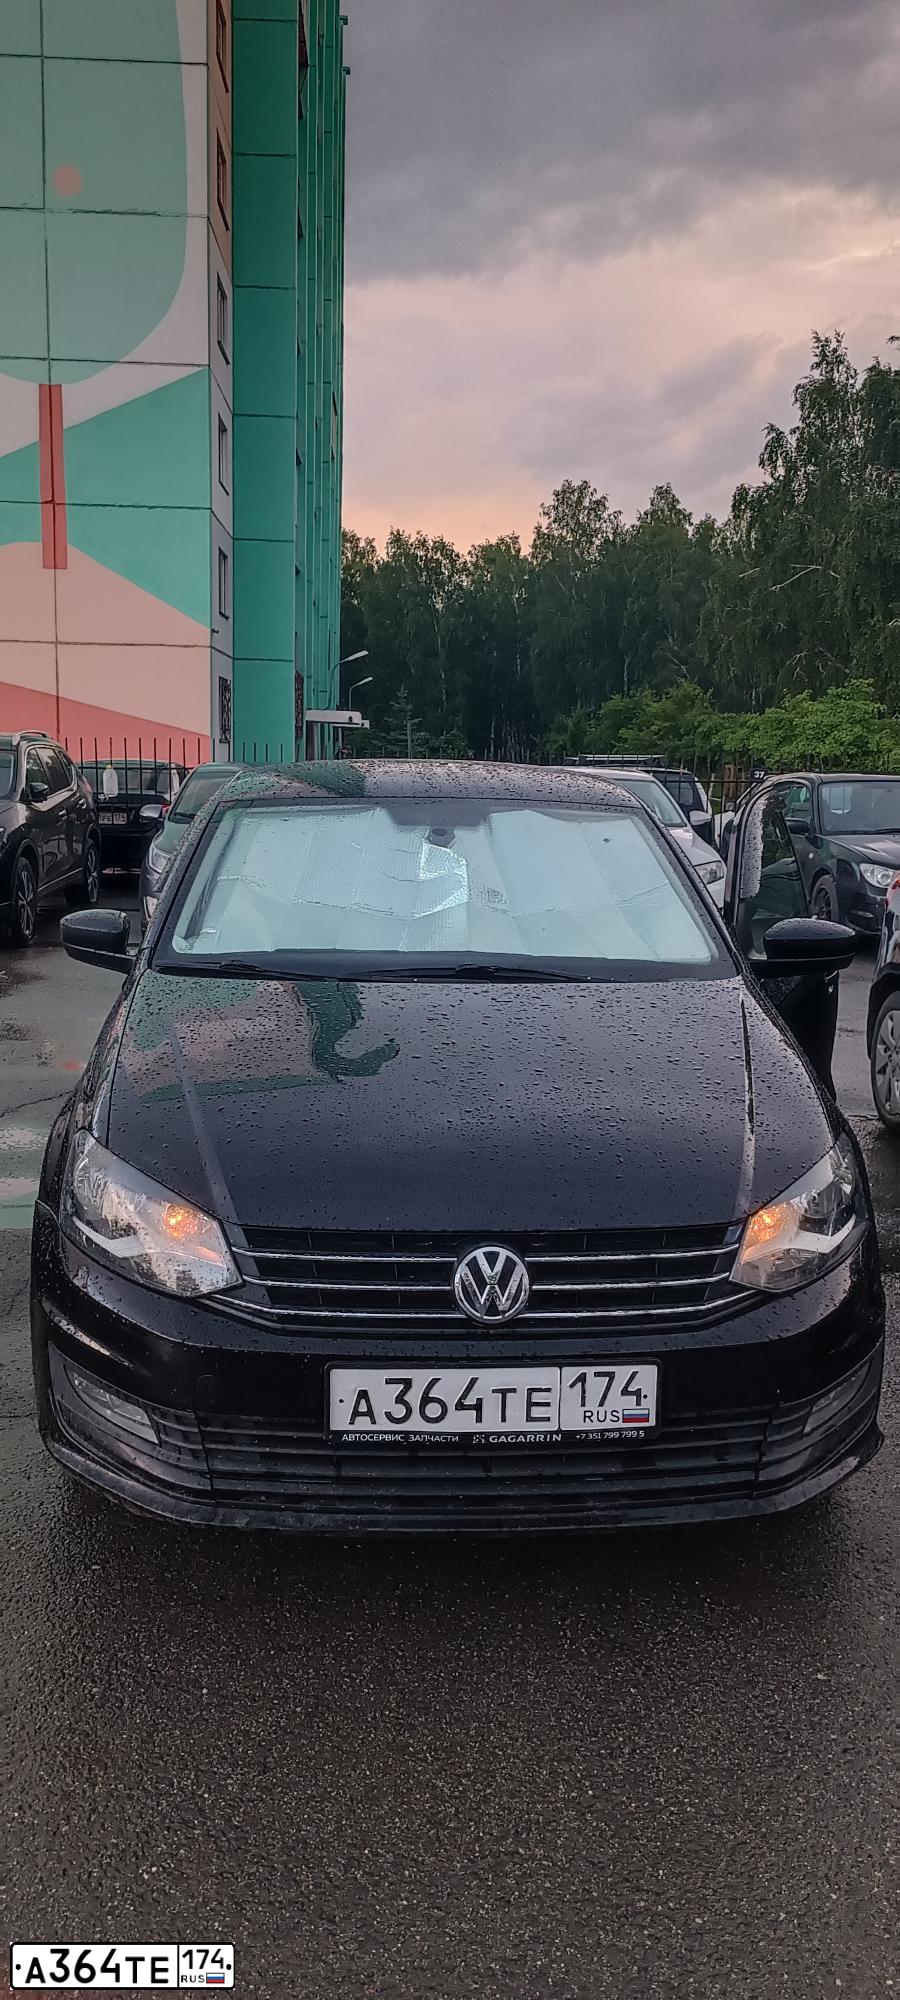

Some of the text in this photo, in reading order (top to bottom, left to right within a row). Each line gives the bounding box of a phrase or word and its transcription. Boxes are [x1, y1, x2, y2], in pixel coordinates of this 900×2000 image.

[348, 1371, 642, 1425] А364ТЕ 174
[583, 1410, 620, 1423] RUS
[341, 1433, 459, 1443] АВТОСЕРВИС ЗАПЧАСТИ
[489, 1433, 562, 1443] GAGARRIN
[587, 1432, 601, 1440] 351
[603, 1431, 620, 1439] 799
[621, 1431, 638, 1439] 799
